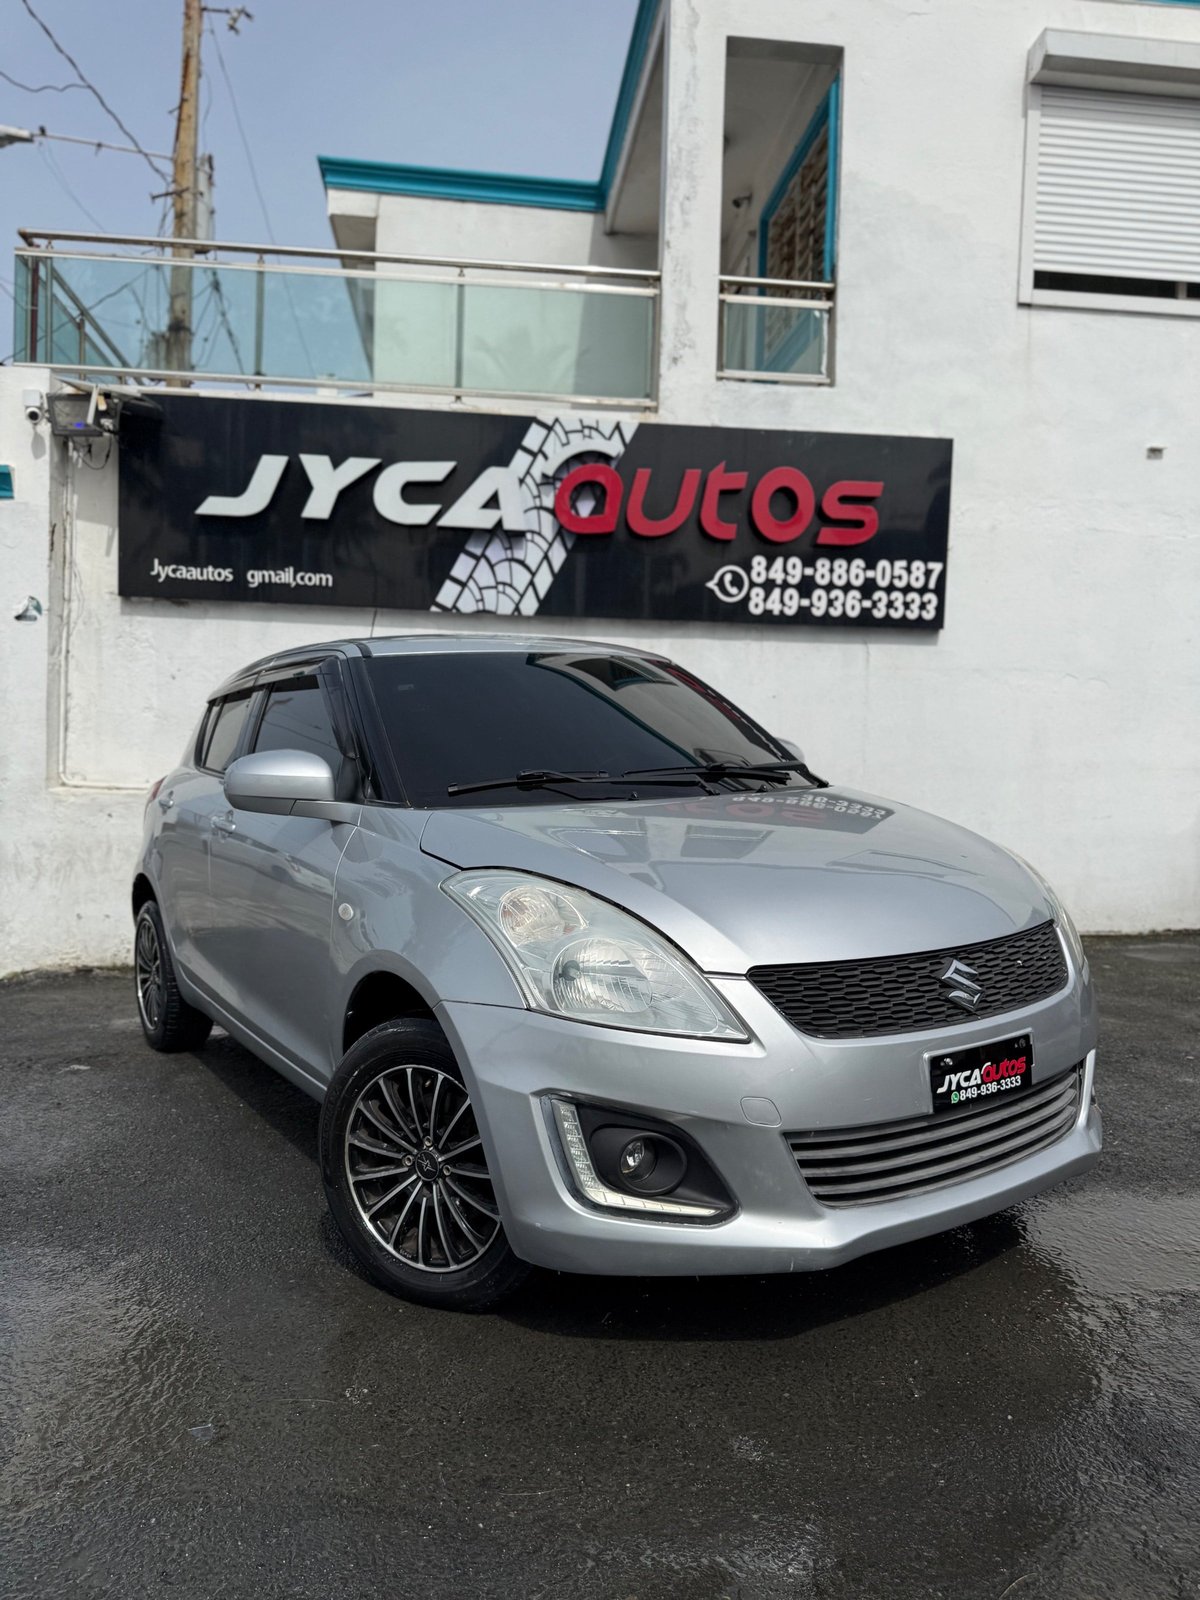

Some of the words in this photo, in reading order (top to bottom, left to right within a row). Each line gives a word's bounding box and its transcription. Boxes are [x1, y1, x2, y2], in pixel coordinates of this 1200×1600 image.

[150, 558, 233, 582] Jycaautos
[749, 555, 943, 590] 849-886-0587
[748, 586, 938, 620] 849-936-3333
[960, 1075, 1021, 1101] 849-936-3333
